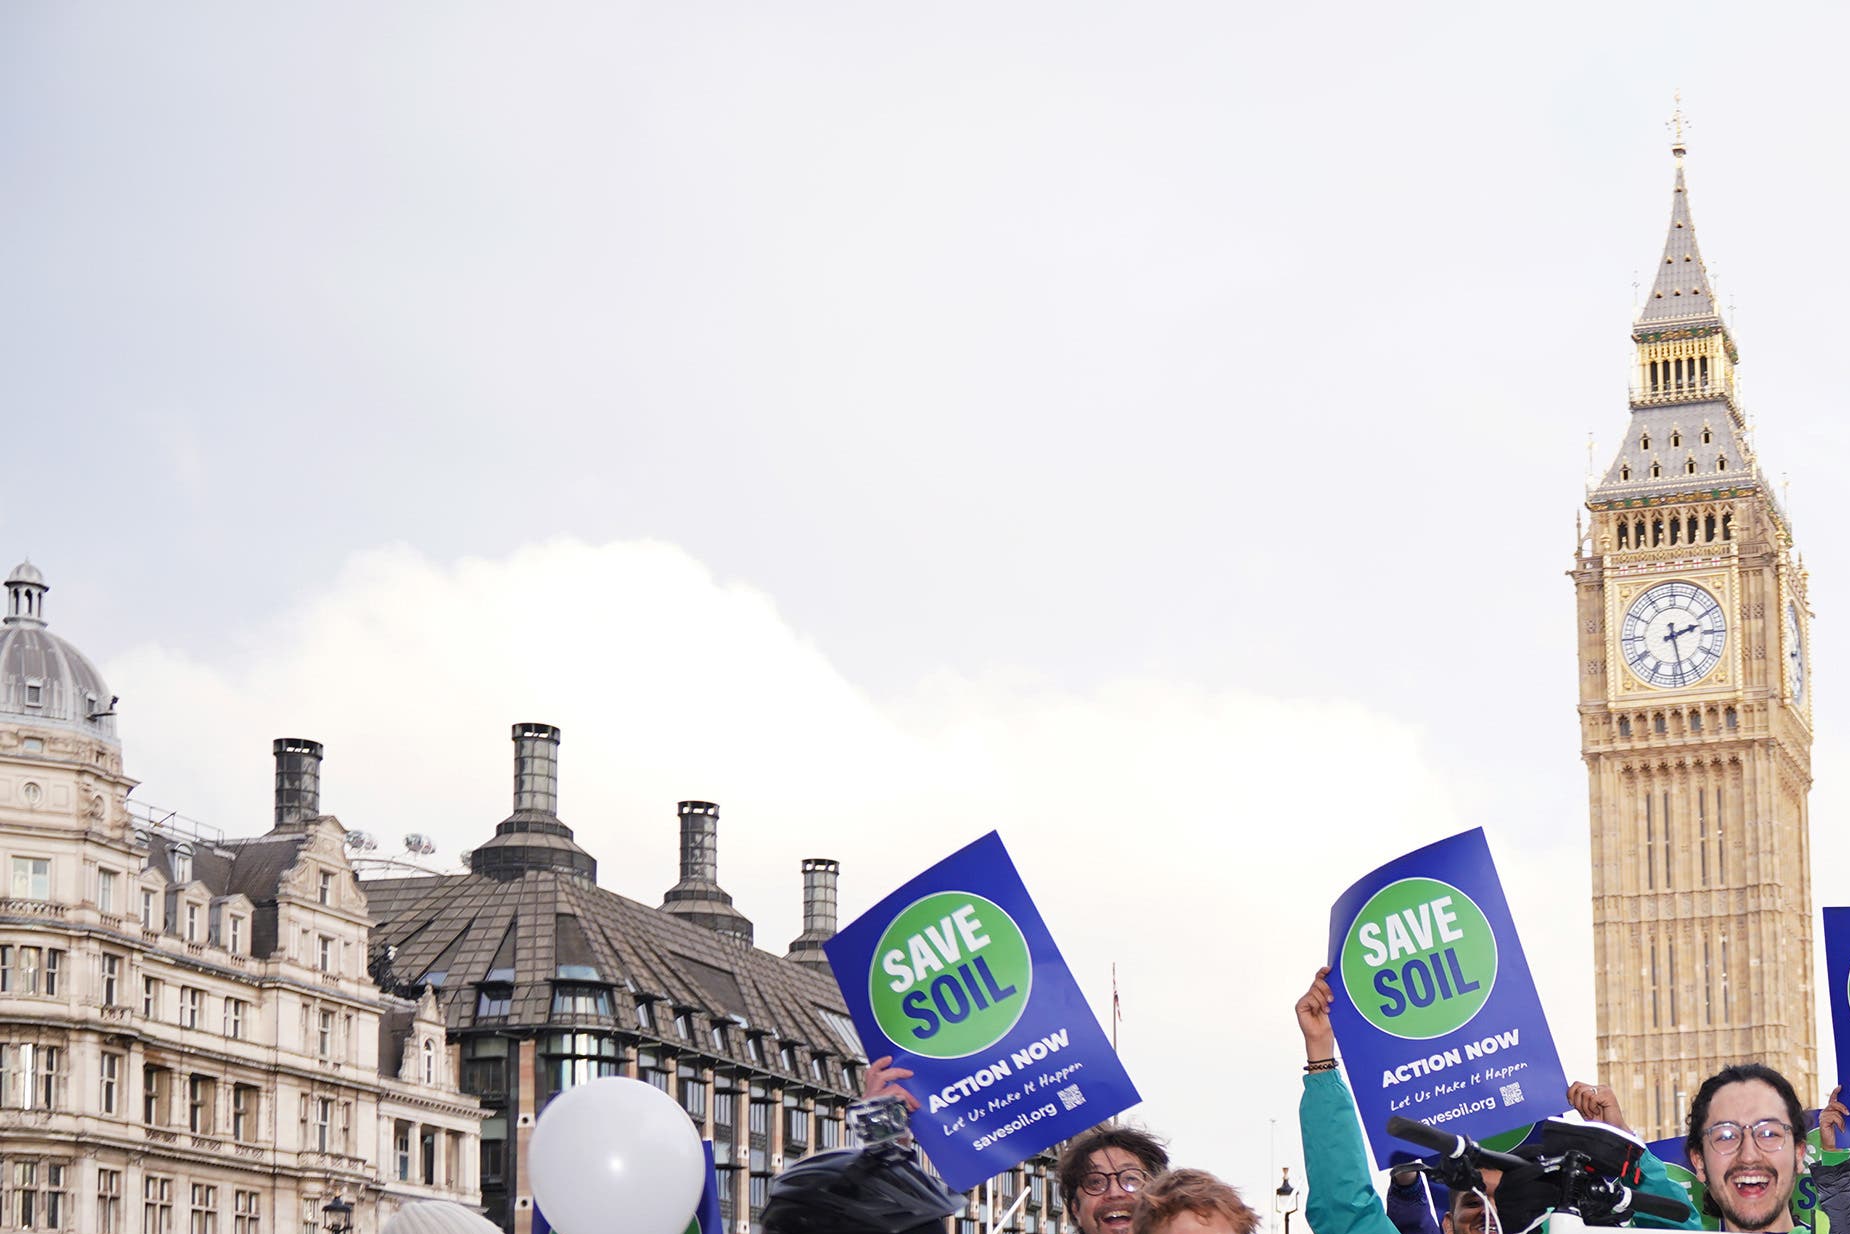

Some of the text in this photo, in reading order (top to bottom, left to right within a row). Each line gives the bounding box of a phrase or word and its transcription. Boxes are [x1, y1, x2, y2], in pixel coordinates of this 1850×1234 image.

[883, 904, 992, 993] SAVE
[1358, 895, 1464, 967] SAVE
[902, 955, 1017, 1040] SOIL
[1373, 947, 1480, 1018] SOIL
[928, 1028, 1070, 1114] ACTION NOW
[1382, 1028, 1520, 1089] ACTION NOW
[1390, 1061, 1529, 1112] Let Us Make It Happen
[943, 1060, 1083, 1136] Let Us Make It Happen
[972, 1102, 1058, 1151] savesoil.org
